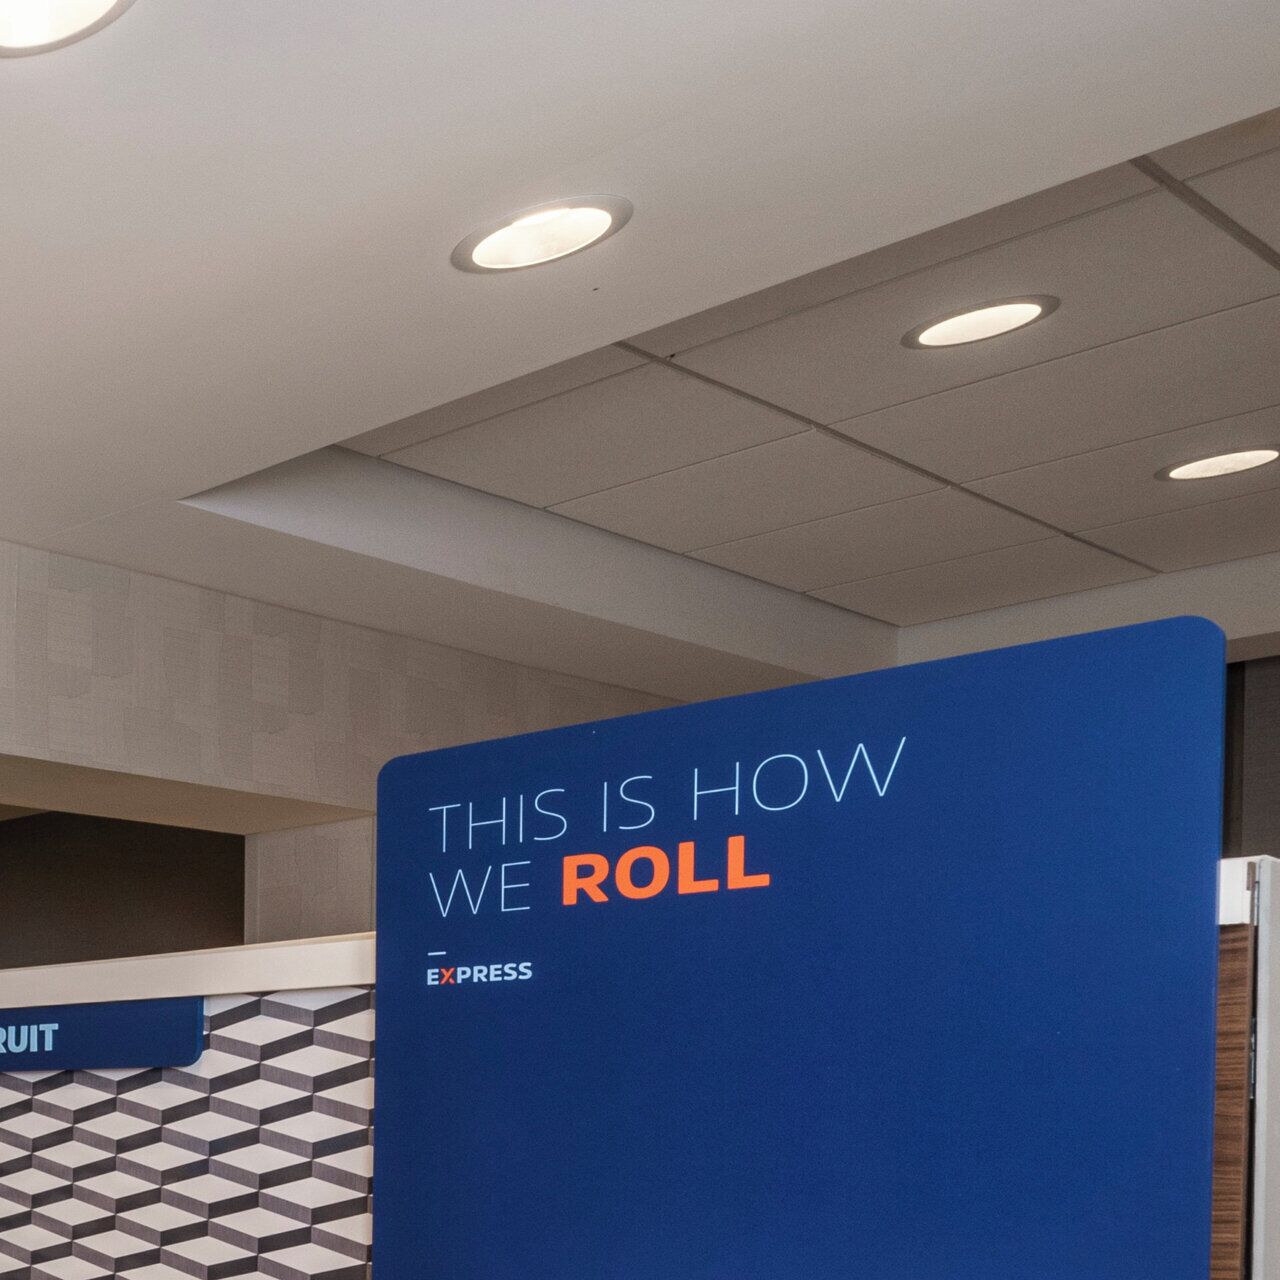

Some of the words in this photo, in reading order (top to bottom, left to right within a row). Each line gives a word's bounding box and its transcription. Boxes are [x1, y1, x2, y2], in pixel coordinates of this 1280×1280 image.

[428, 787, 568, 853] THIS
[603, 775, 656, 833] IS
[693, 736, 907, 821] HOW
[428, 860, 532, 918] WE
[561, 835, 771, 906] ROLL
[426, 962, 534, 986] EXPRESS
